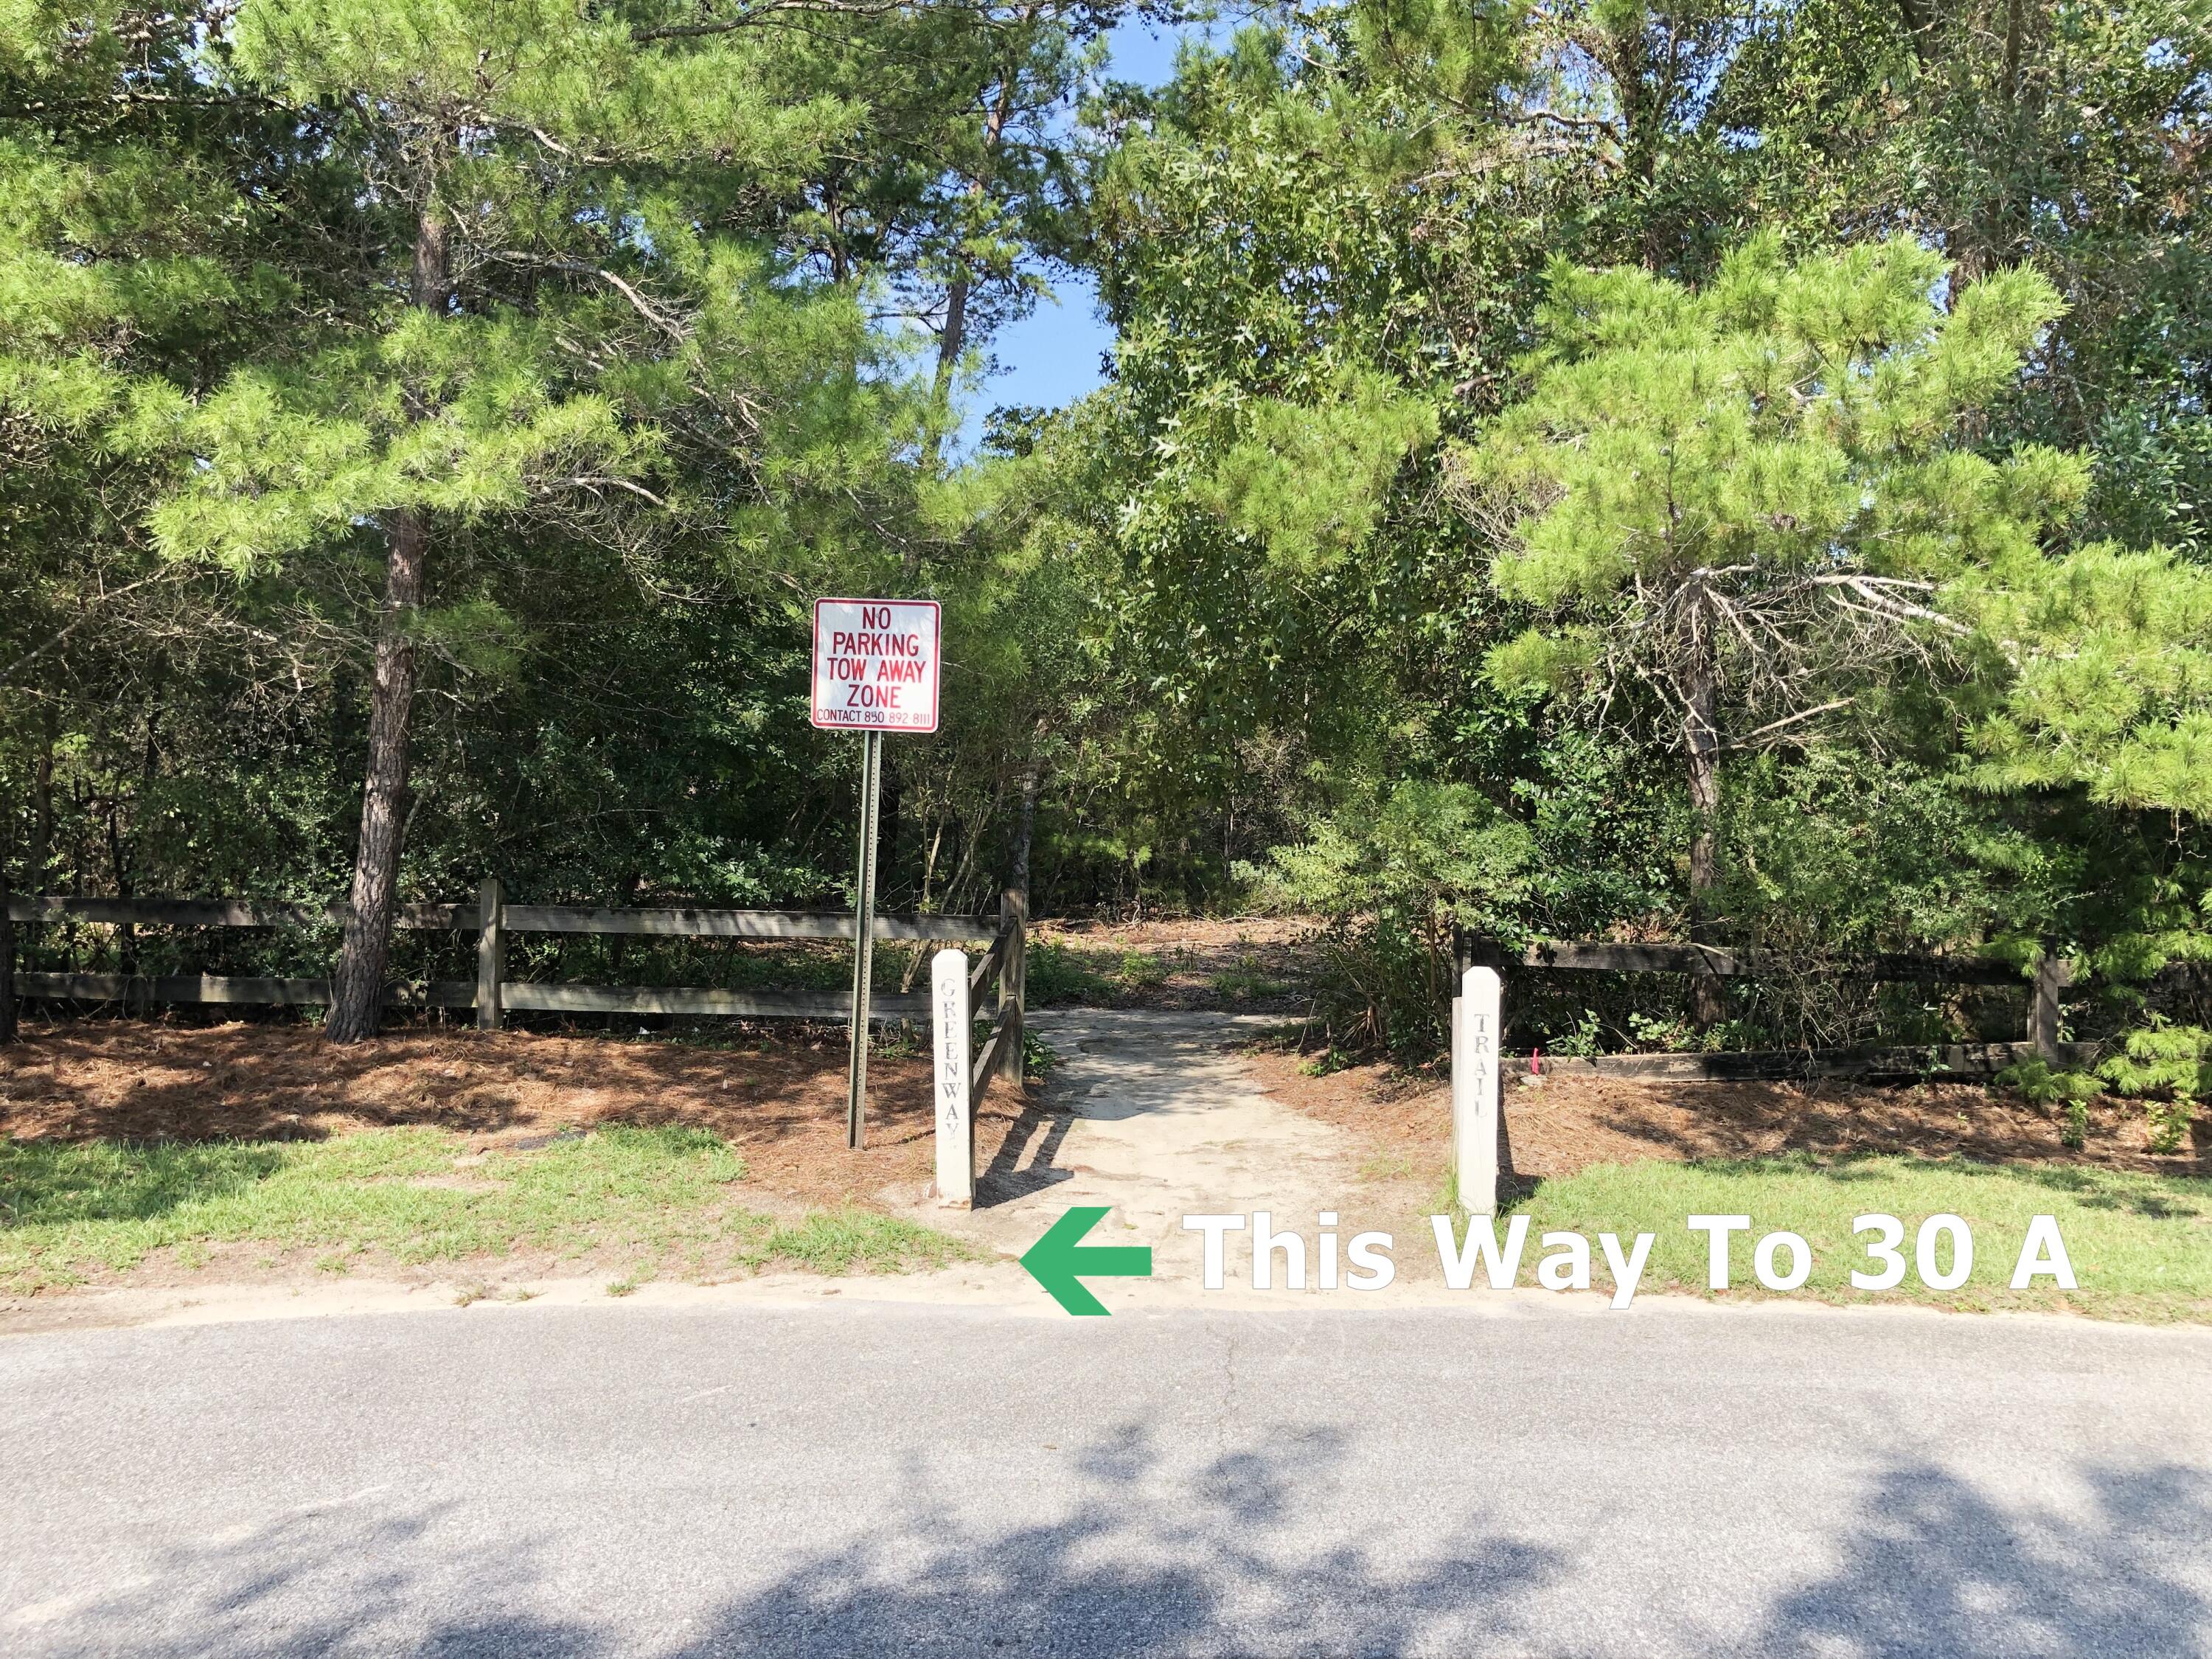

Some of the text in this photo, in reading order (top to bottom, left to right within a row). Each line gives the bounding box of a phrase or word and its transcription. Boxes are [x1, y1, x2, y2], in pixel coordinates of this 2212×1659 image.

[863, 607, 891, 629] NO
[832, 632, 919, 657] PARKING
[827, 658, 926, 683] TOW AWAY
[847, 684, 902, 709] ZONE
[817, 709, 930, 725] CONTACT 850 892 8111
[941, 978, 961, 1140] GREENWAY
[1474, 1014, 1490, 1119] TRAIL
